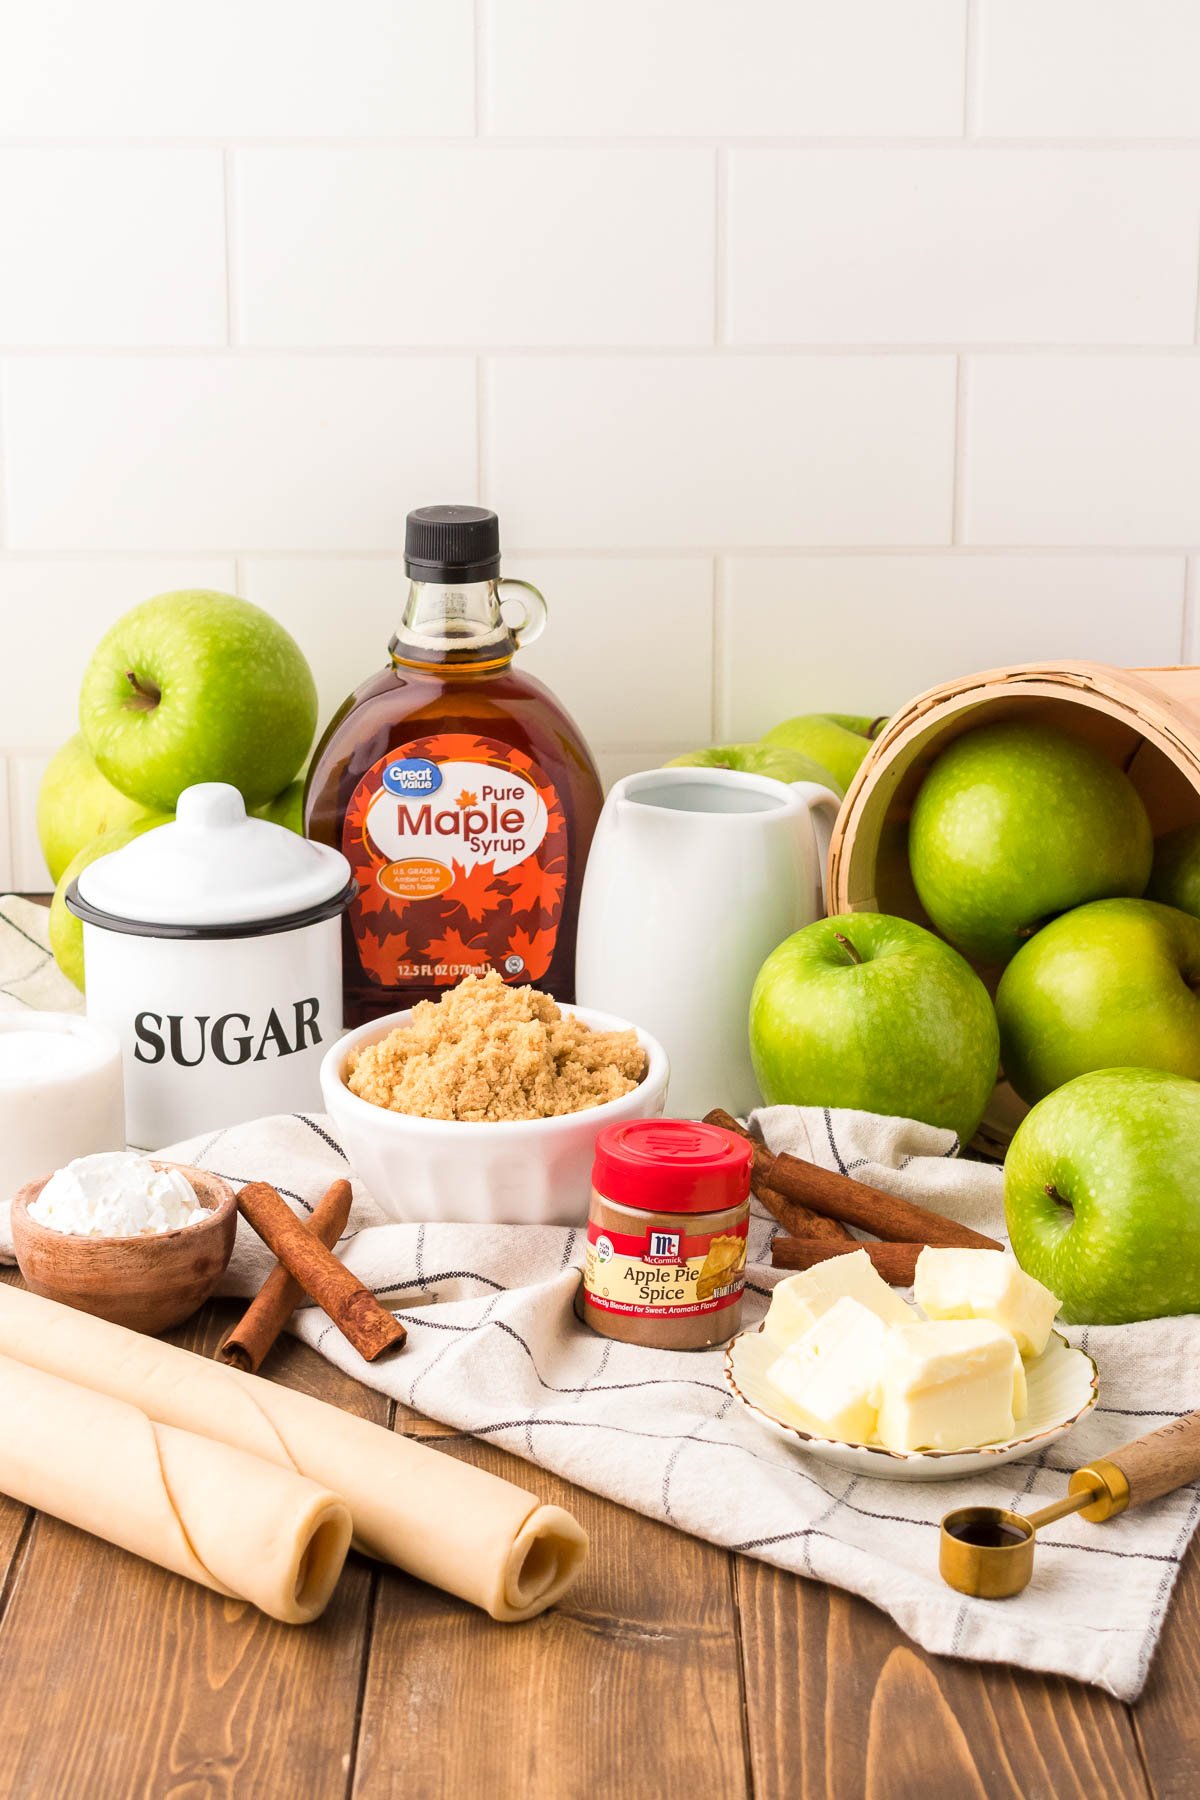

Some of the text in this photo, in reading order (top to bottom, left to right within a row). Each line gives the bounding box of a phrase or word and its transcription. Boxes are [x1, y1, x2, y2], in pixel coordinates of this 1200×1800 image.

[389, 767, 432, 781] Great
[400, 779, 432, 789] Value
[482, 785, 525, 801] Pure
[397, 803, 525, 842] Maple
[470, 836, 526, 856] Syrup
[407, 867, 433, 875] GRADE
[434, 867, 441, 875] A
[398, 963, 491, 976] 12.5 FL OZ (370mL)
[134, 997, 323, 1067] SUGAR
[644, 1255, 682, 1264] McCormick
[624, 1266, 699, 1286] Apple Pie
[639, 1285, 685, 1304] Spice
[590, 1293, 609, 1308] Perfectly
[610, 1301, 633, 1311] Blended
[645, 1306, 668, 1314] Sweet,
[668, 1305, 699, 1314] Aromatic
[700, 1300, 719, 1310] Flavor
